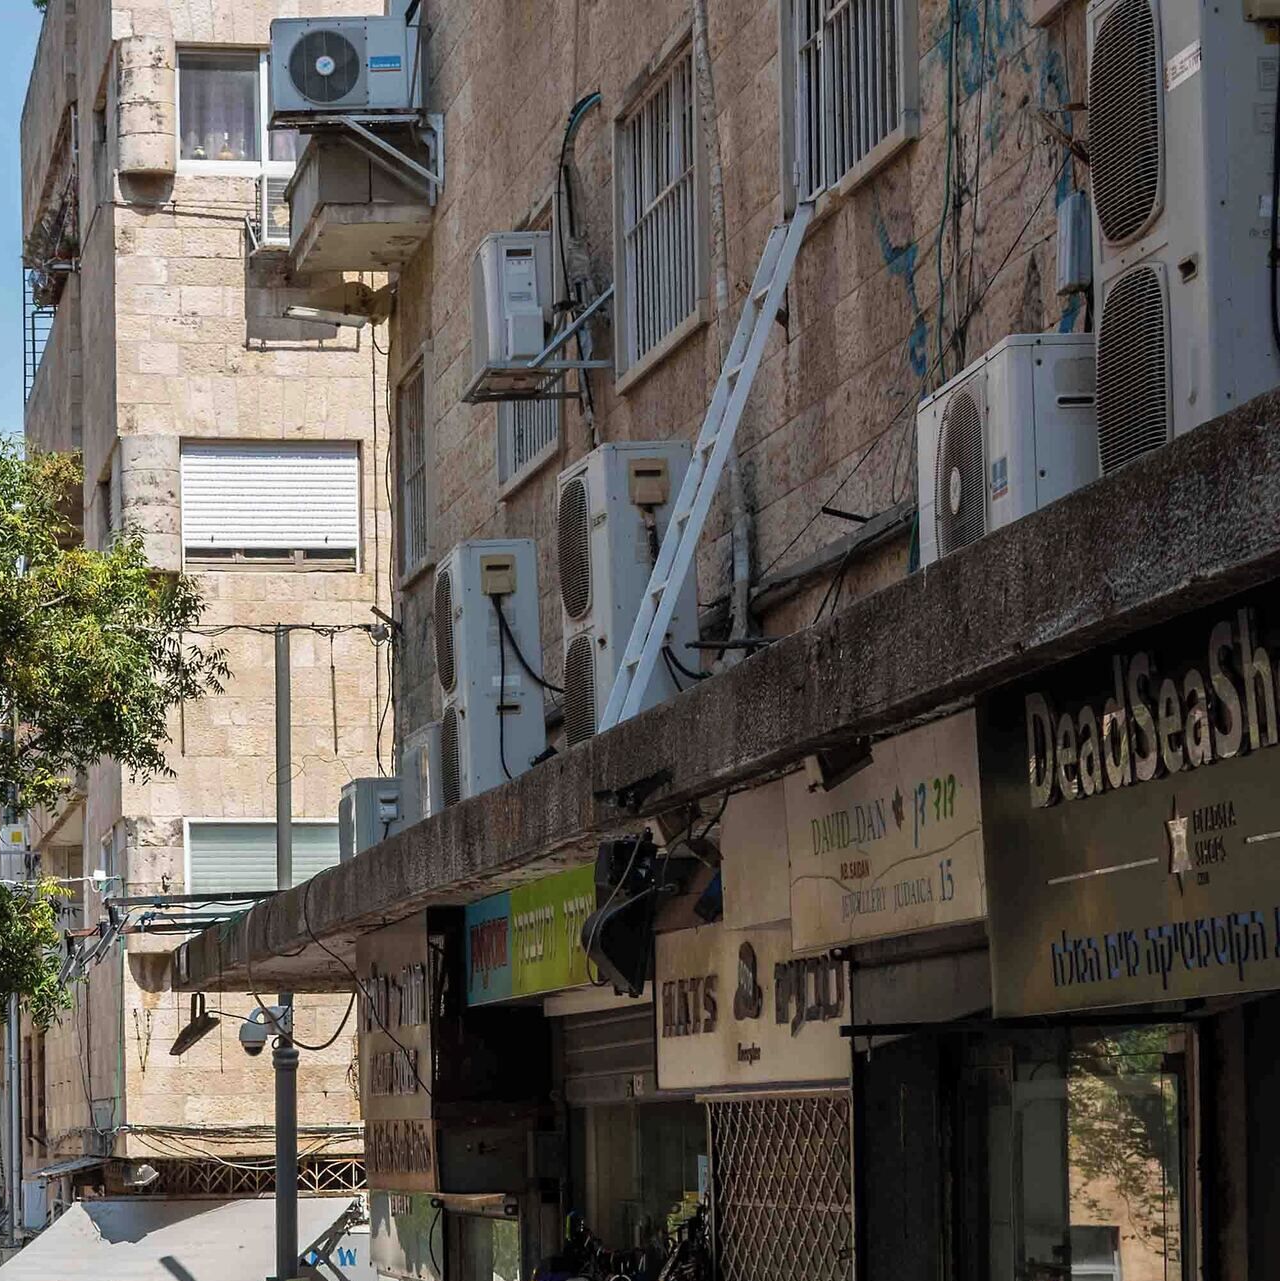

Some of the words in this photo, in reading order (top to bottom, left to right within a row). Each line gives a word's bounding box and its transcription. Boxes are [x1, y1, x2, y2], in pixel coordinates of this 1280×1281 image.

[893, 877, 934, 914] JUDAICA
[1051, 928, 1101, 987] המלח
[1104, 930, 1139, 980] מים
